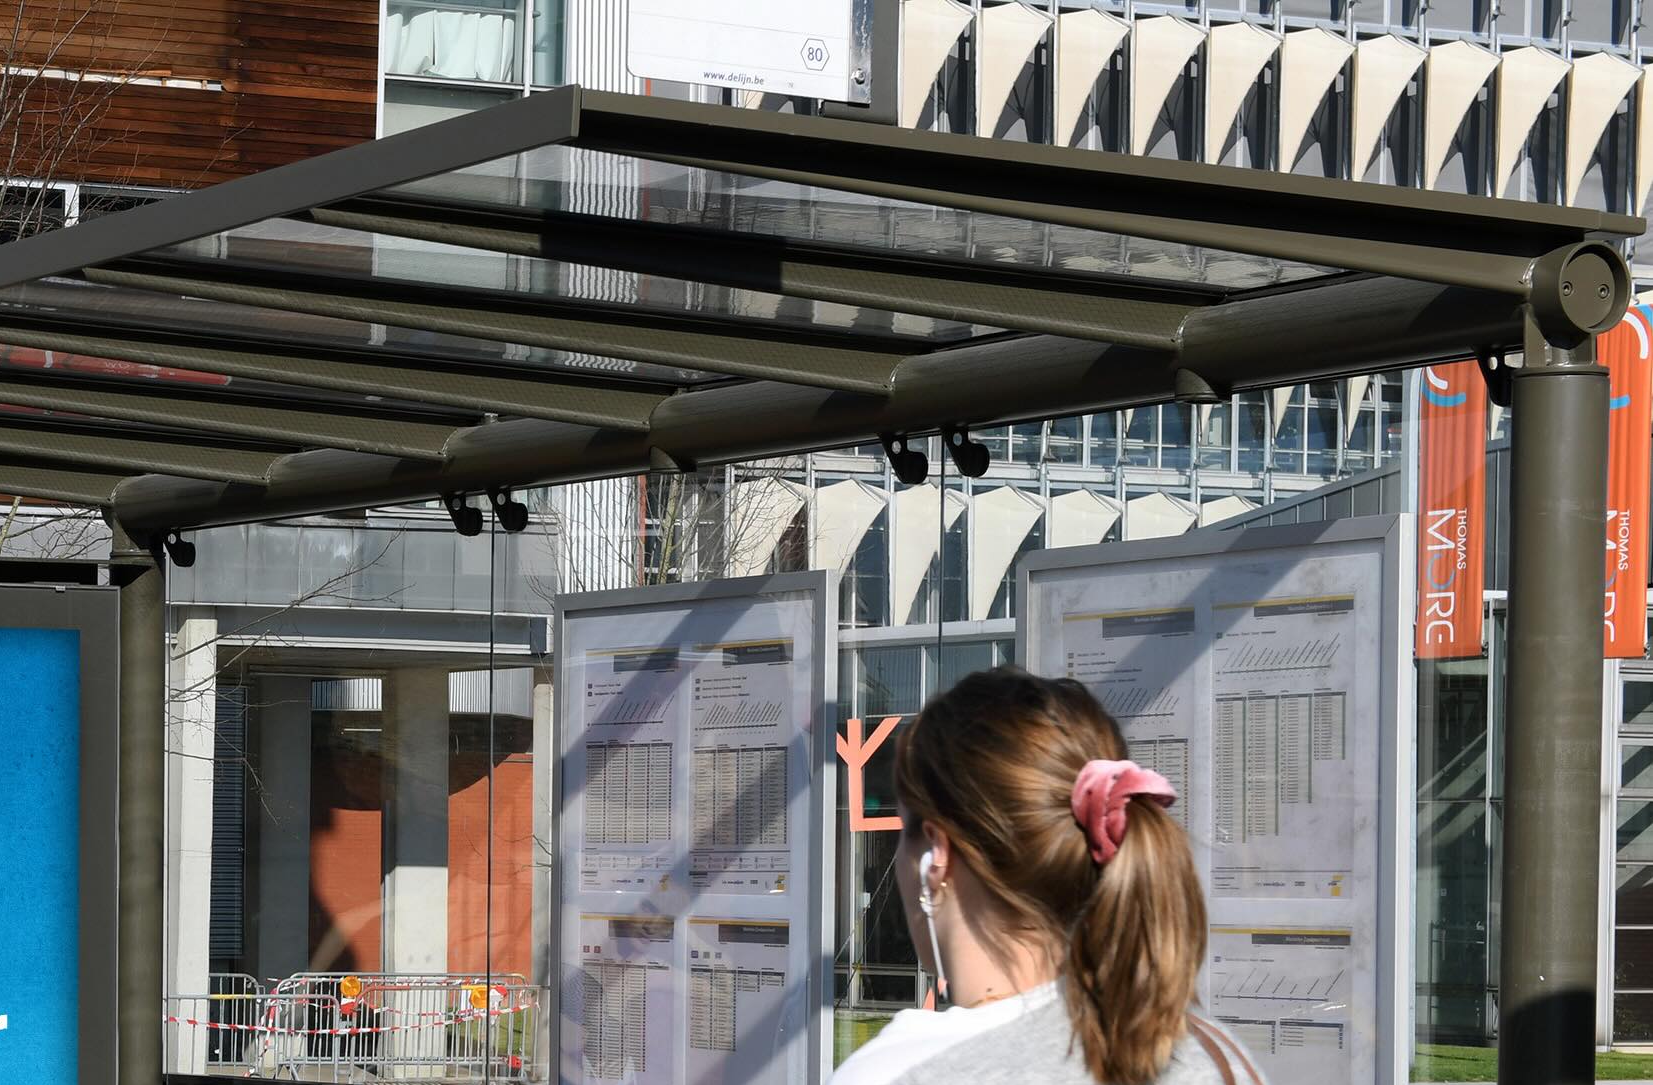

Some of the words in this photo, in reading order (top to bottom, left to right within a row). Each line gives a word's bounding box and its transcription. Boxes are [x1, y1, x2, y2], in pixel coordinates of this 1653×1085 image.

[703, 70, 765, 85] www.delijn.be
[807, 47, 823, 62] 80
[1456, 508, 1468, 570] THOMAS
[1618, 509, 1630, 571] THOMAS
[1426, 508, 1456, 645] MORE
